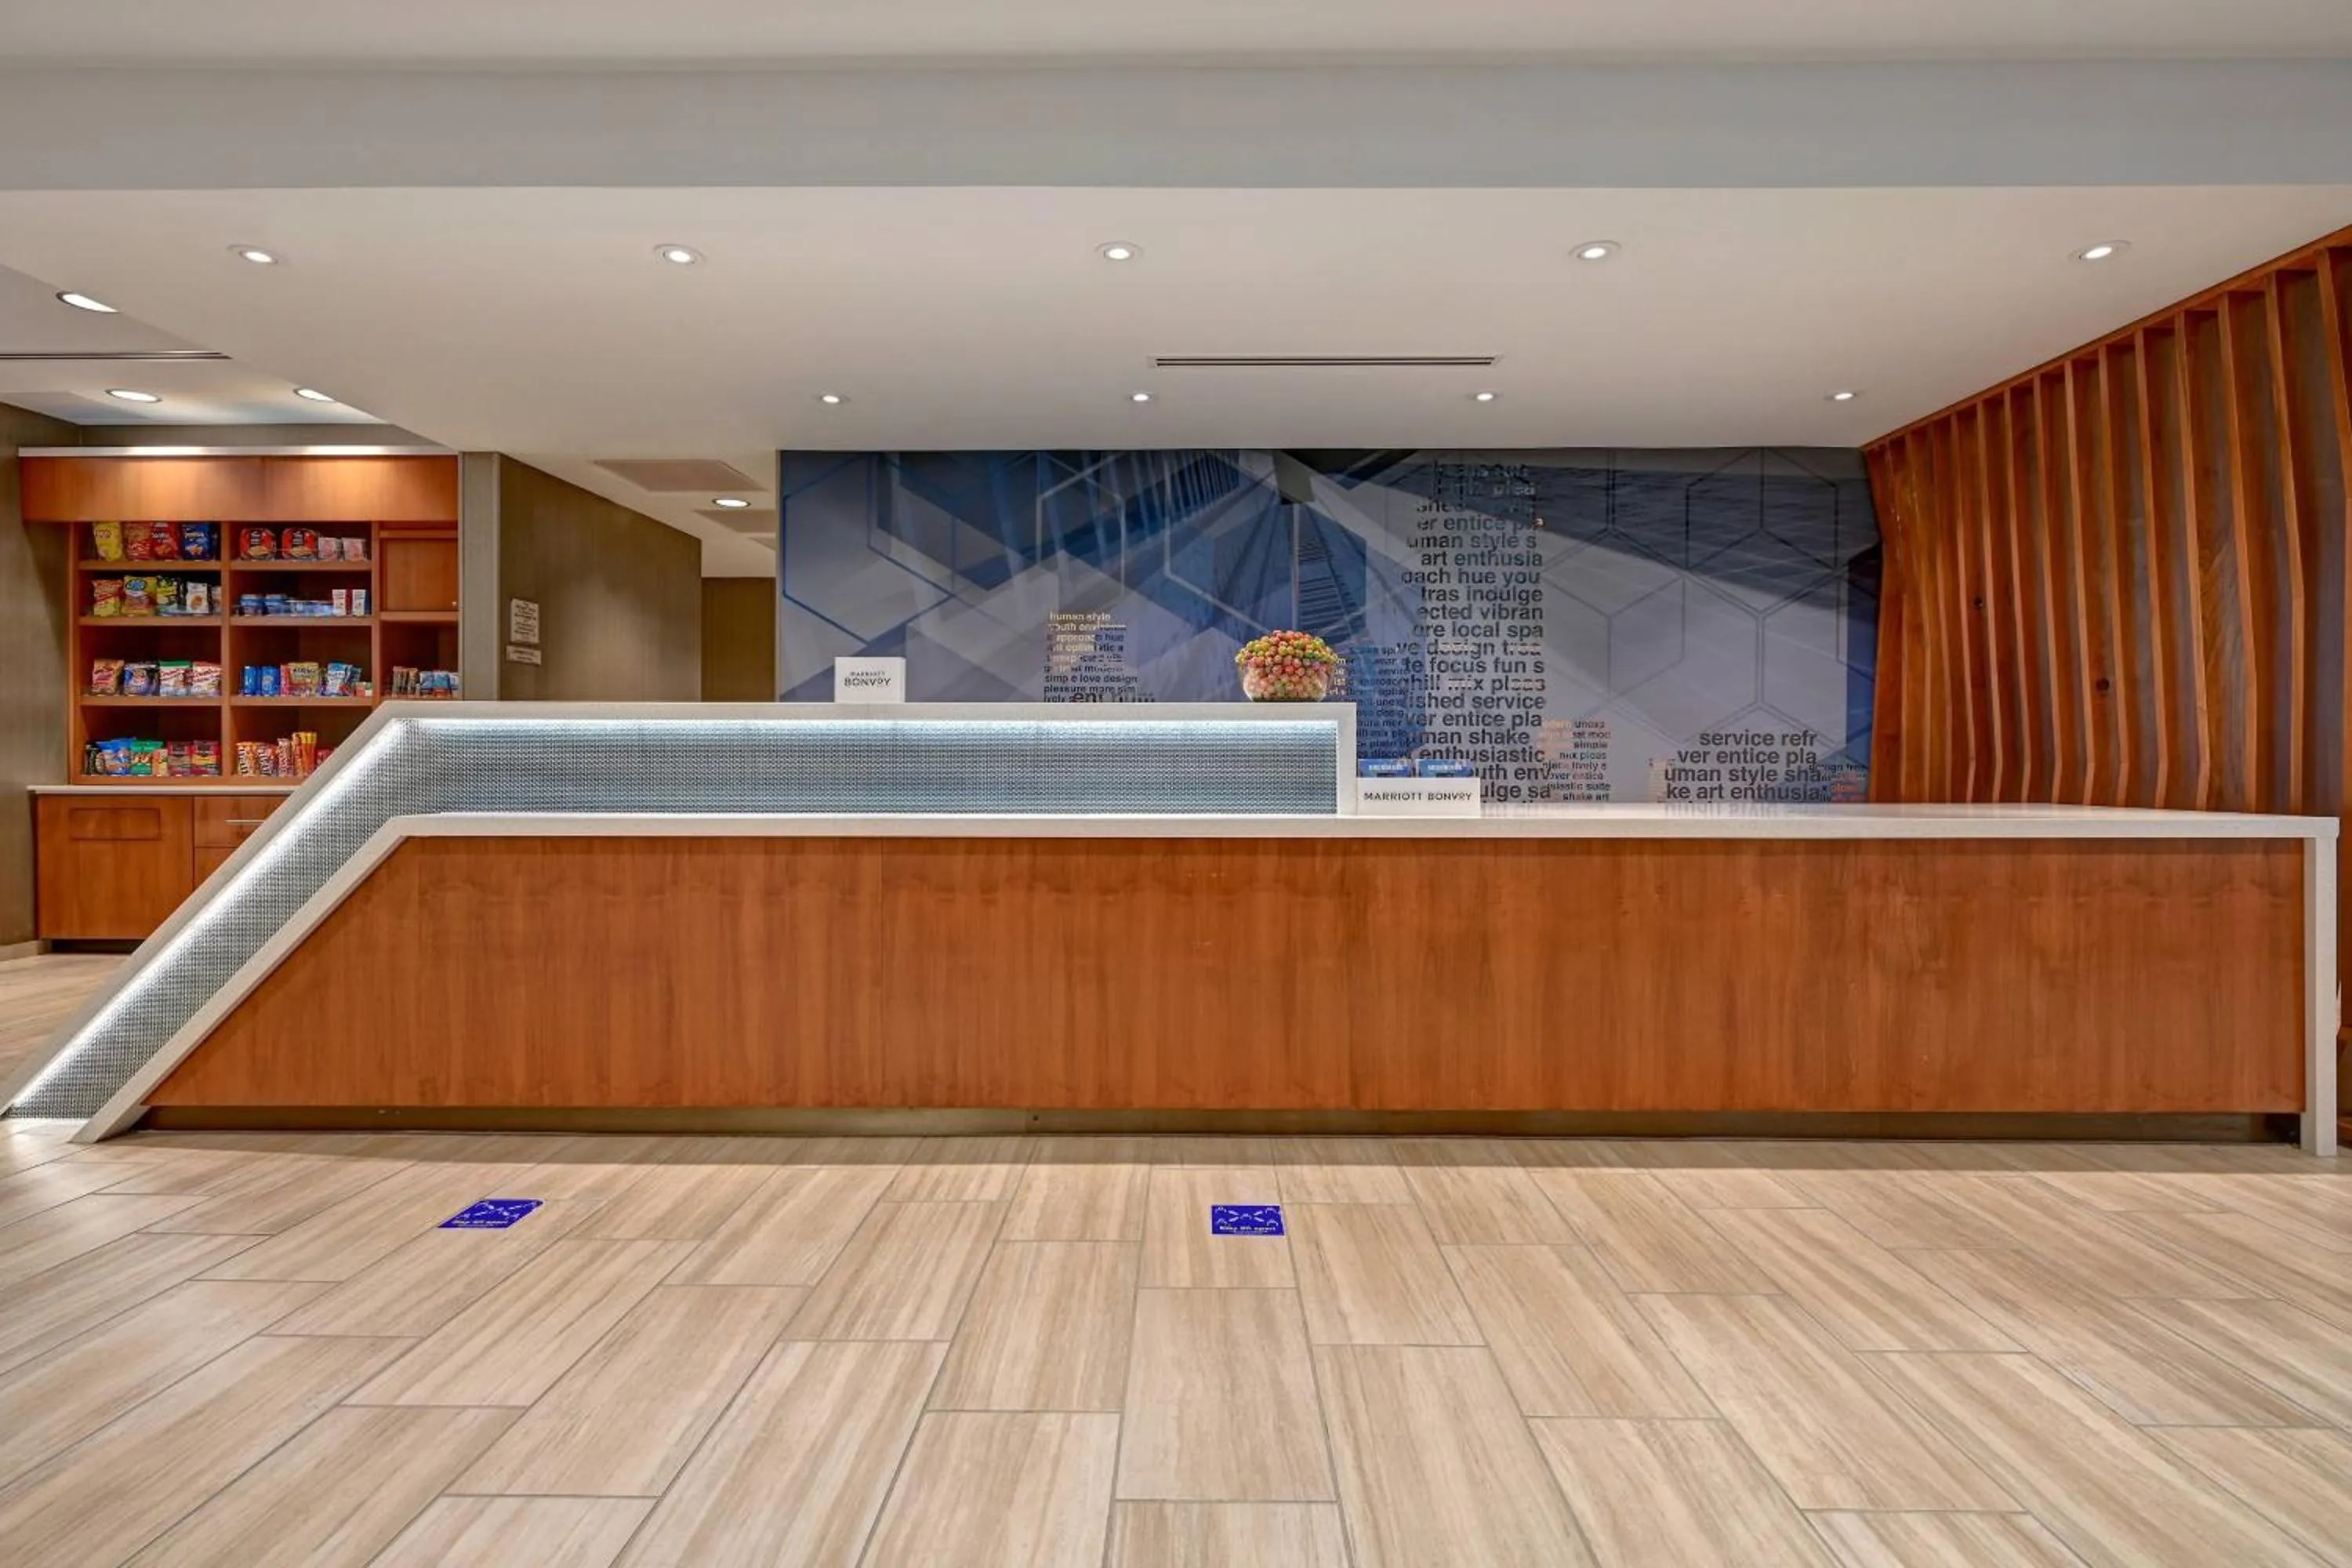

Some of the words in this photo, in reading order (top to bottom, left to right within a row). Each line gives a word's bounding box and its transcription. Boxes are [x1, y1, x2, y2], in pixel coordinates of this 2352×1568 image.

[1443, 514, 1505, 531] entice
[1470, 532, 1519, 554] style
[1421, 551, 1448, 567] art
[1454, 550, 1542, 567] enthusia
[1457, 568, 1497, 584] hue
[1501, 572, 1541, 590] you
[1466, 586, 1543, 606] indulge
[1479, 603, 1543, 620] vibran
[1451, 622, 1501, 637] local
[1506, 624, 1544, 642] spa
[1429, 657, 1487, 673] focus
[1494, 657, 1526, 673] fun
[1533, 659, 1544, 673] s
[844, 677, 891, 687] BONVOY
[1044, 674, 1078, 685] simpe
[1472, 693, 1546, 710] service
[1442, 711, 1504, 728] entice
[1511, 710, 1542, 731] pla
[1468, 728, 1530, 745] shake
[1699, 729, 1775, 746] service
[1781, 730, 1817, 746] refr
[1419, 745, 1545, 763] enthusiastic
[1678, 750, 1710, 764] ver
[1717, 748, 1780, 764] entice
[1787, 747, 1817, 768] pla
[1664, 768, 1720, 782] uman
[1728, 765, 1778, 786] style
[1784, 765, 1821, 782] sha
[1363, 792, 1422, 801] MARRIOTT
[1427, 792, 1472, 801] BONVOY
[1667, 784, 1690, 799] ke
[1696, 785, 1724, 799] art
[1730, 784, 1820, 800] enthusia
